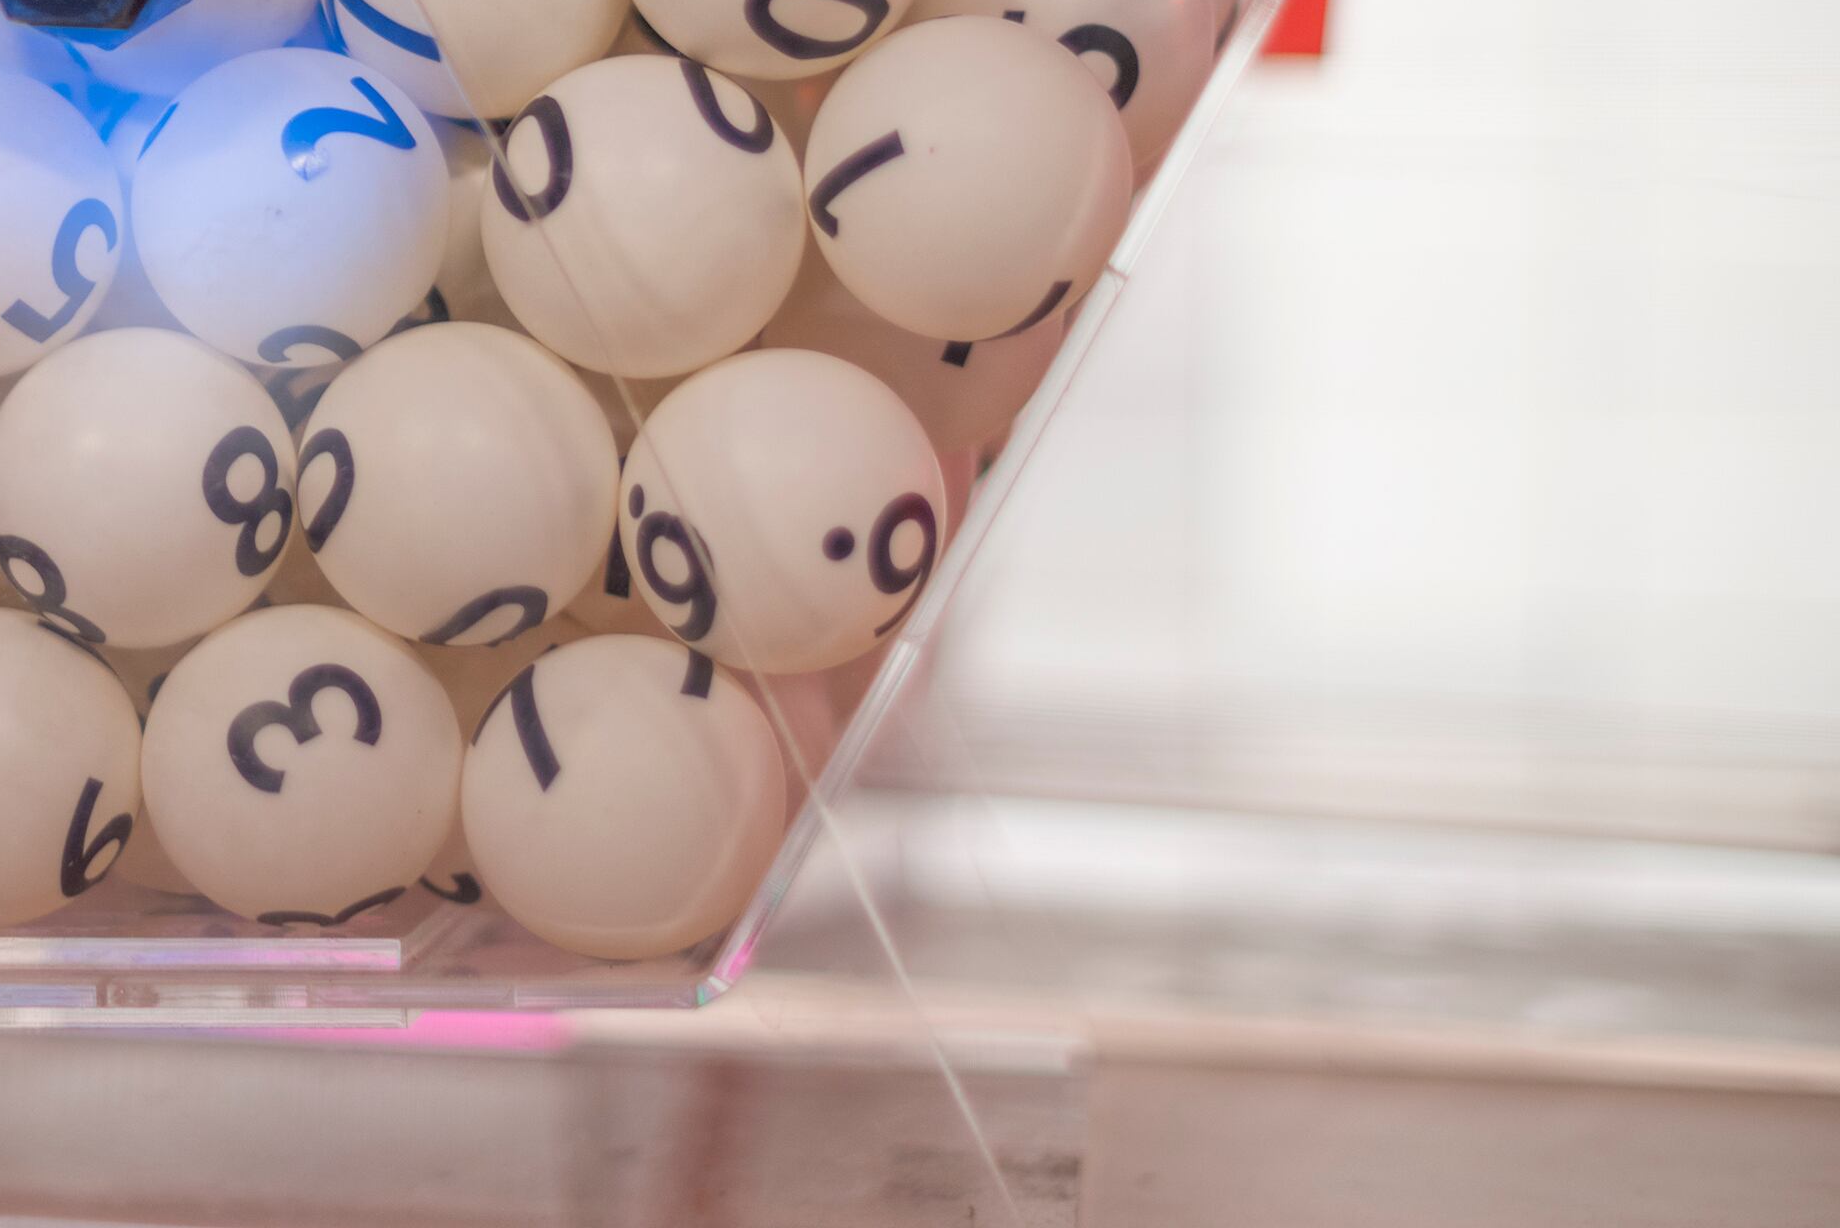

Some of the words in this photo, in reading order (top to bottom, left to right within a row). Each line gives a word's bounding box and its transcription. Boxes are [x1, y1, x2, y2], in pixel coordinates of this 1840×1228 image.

[493, 94, 573, 222] 0
[0, 197, 118, 344] 5
[202, 425, 293, 577] 8
[227, 662, 382, 794] 3
[60, 776, 134, 898] 6
